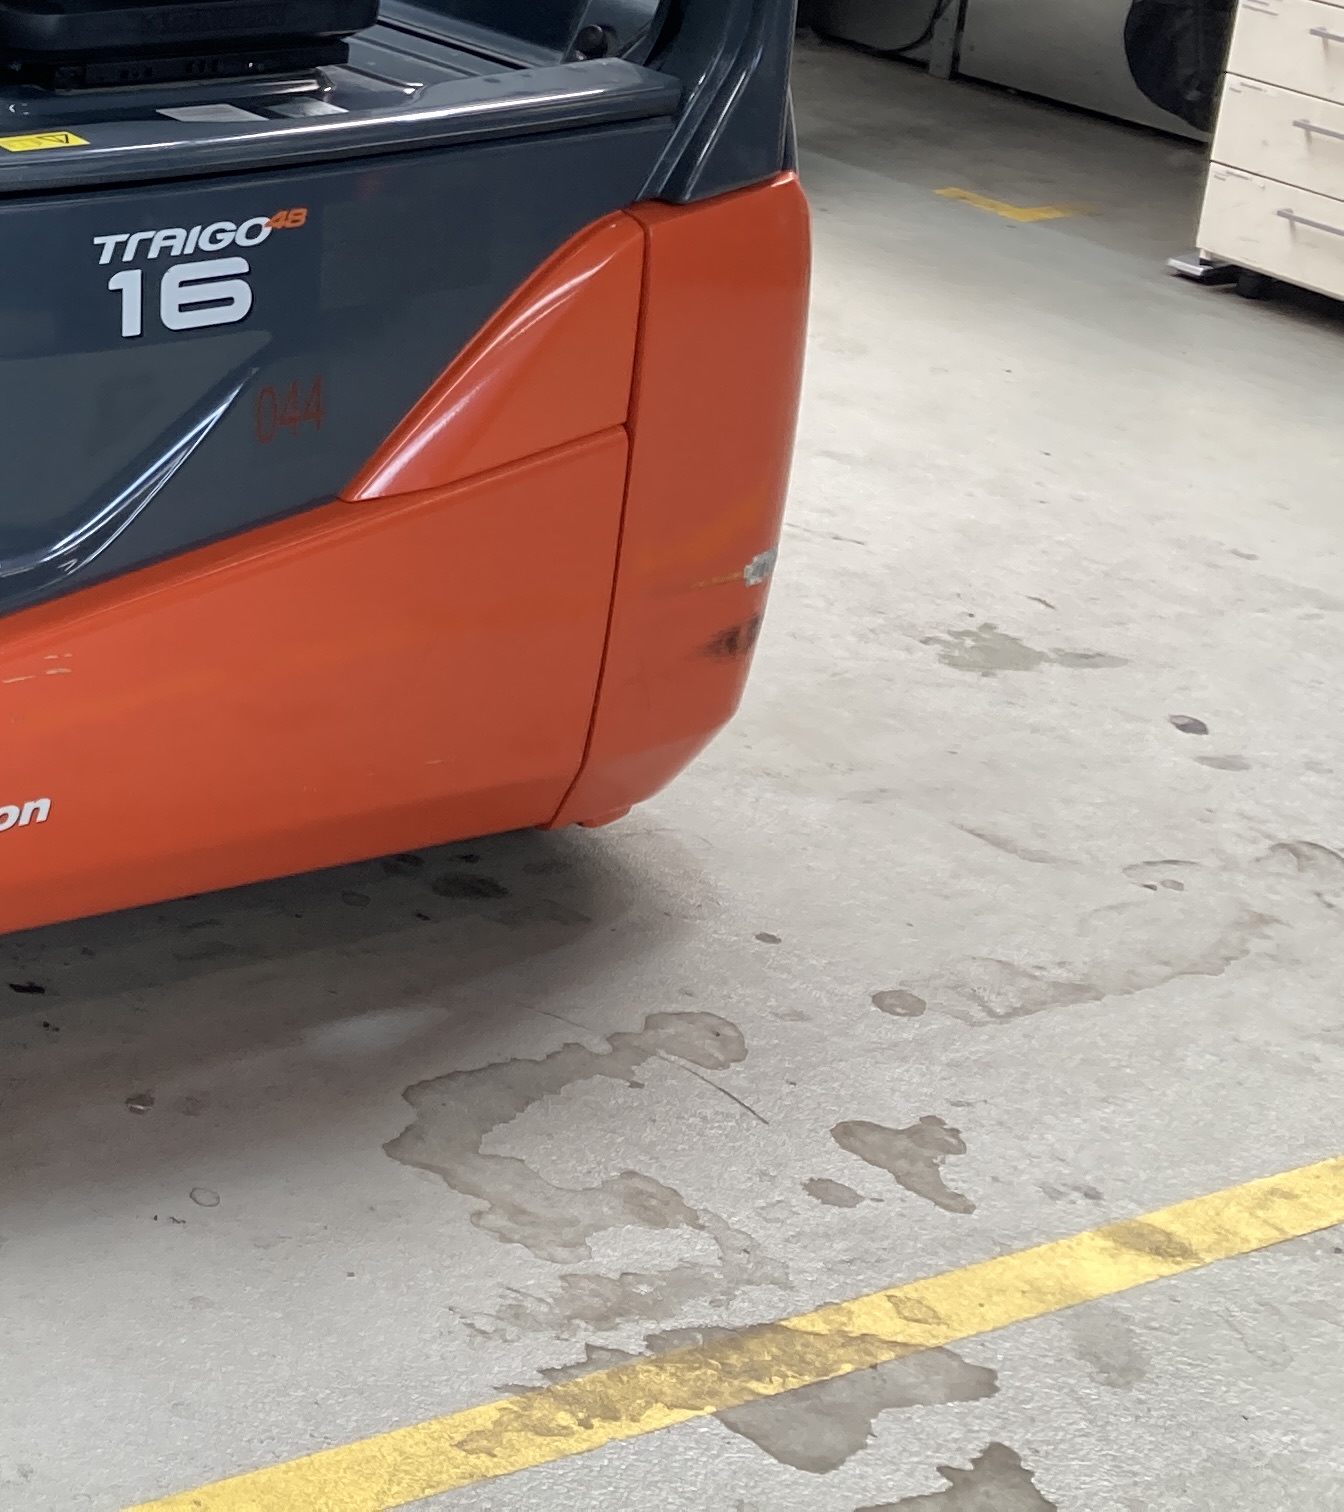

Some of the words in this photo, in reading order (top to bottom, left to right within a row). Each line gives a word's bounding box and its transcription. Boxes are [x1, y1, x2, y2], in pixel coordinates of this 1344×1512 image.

[94, 216, 272, 265] TRAIGO
[265, 207, 308, 230] 48
[108, 256, 253, 338] 16
